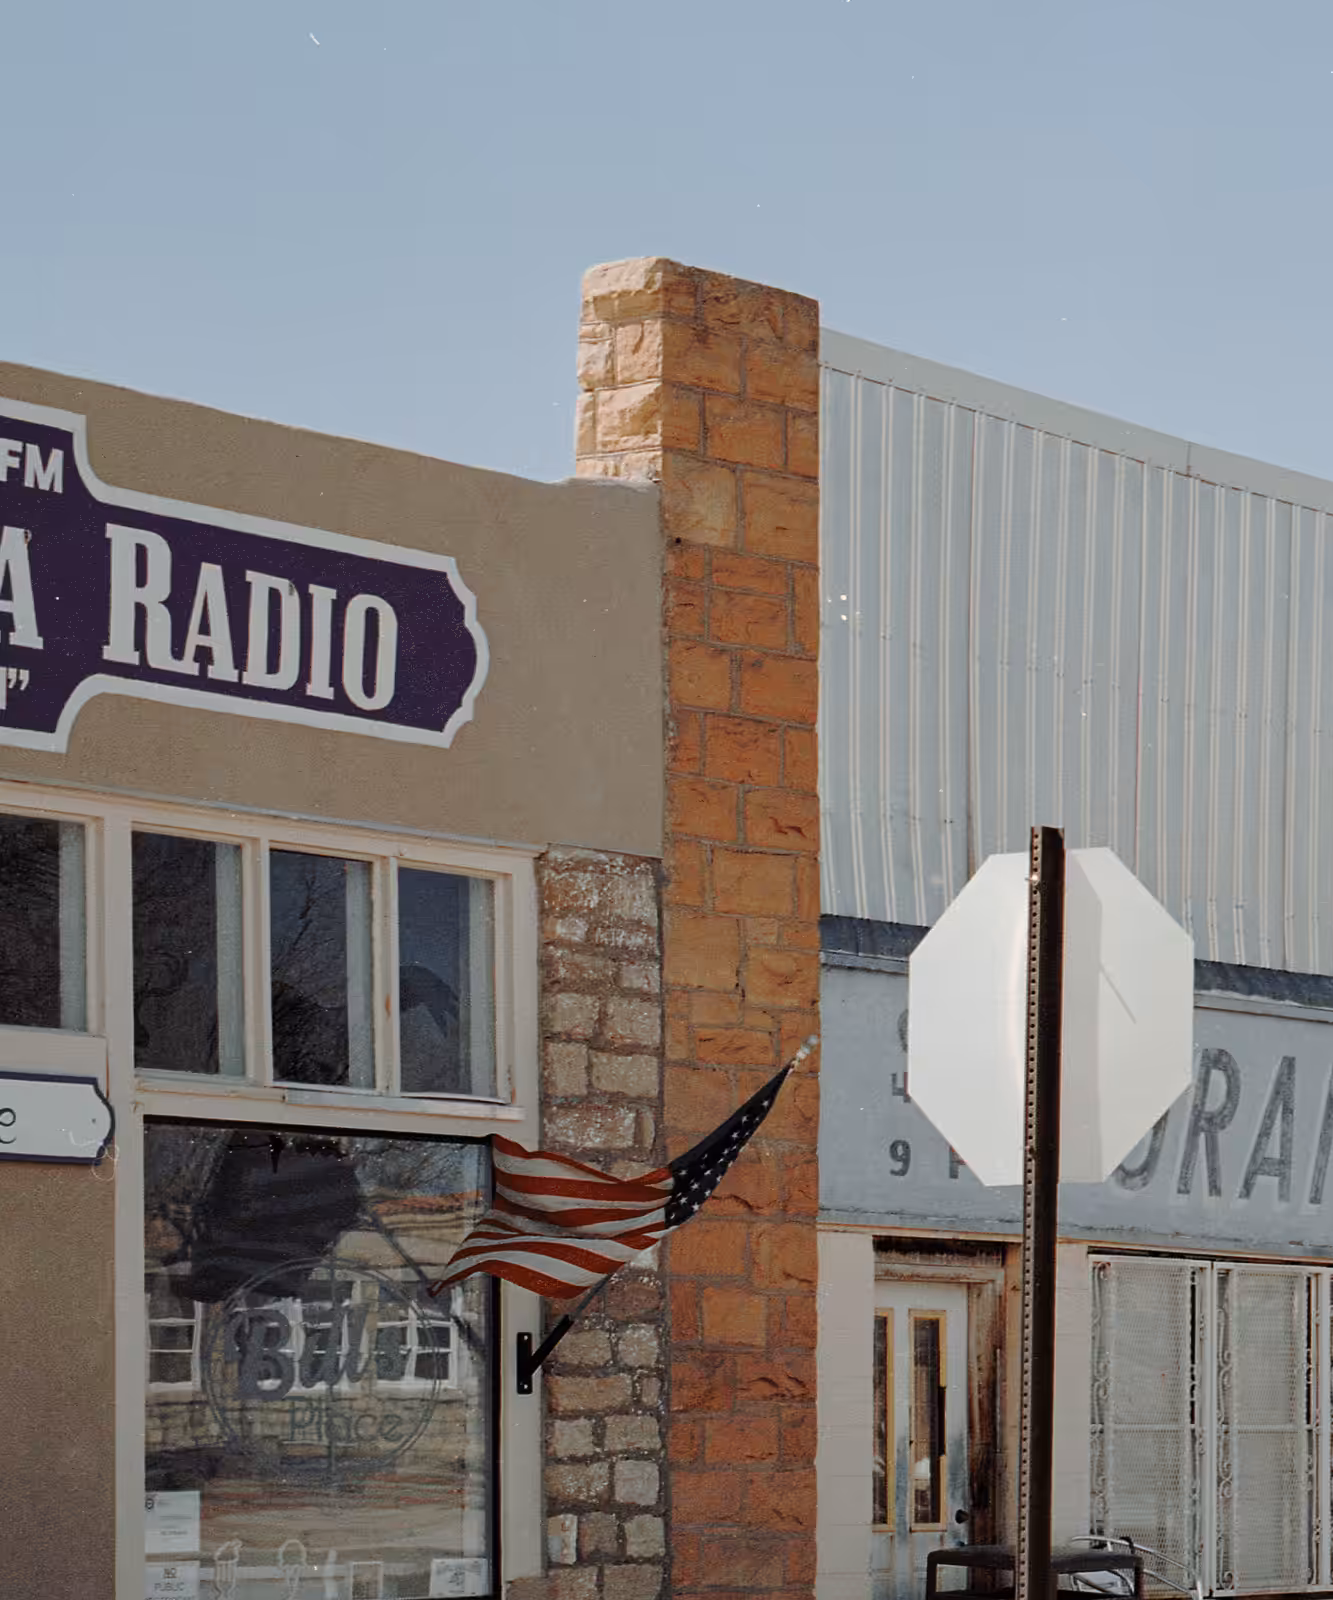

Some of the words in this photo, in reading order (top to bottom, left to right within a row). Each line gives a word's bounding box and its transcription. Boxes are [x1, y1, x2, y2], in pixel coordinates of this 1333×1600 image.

[102, 523, 398, 712] RADIO
[889, 1139, 912, 1177] 9
[289, 1404, 405, 1443] Place
